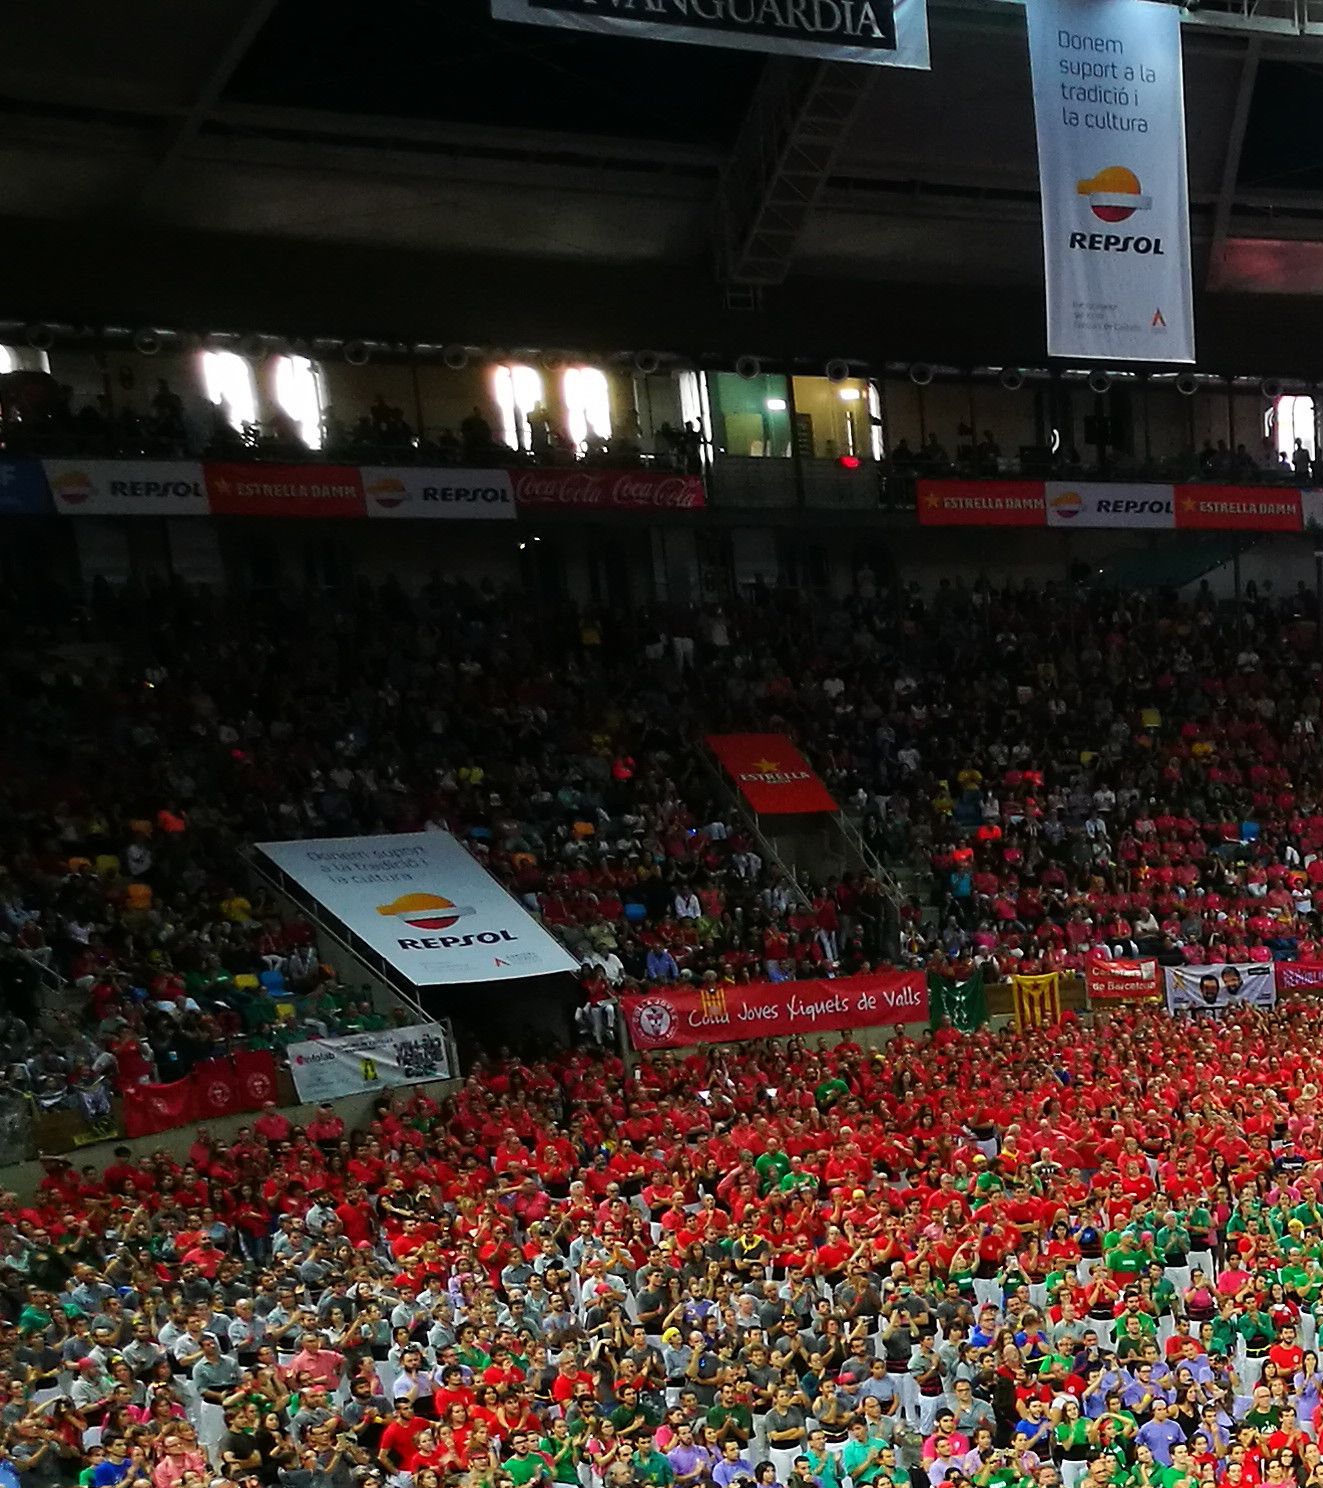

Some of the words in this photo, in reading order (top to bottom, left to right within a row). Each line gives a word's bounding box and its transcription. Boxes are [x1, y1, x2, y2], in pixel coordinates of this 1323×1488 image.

[1058, 30, 1123, 55] Donem
[1059, 59, 1118, 81] suport
[1124, 67, 1135, 82] a
[1140, 64, 1156, 84] la
[1061, 83, 1130, 107] tradició
[1134, 89, 1139, 107] i
[1063, 107, 1079, 128] la
[1085, 110, 1149, 134] cultura
[1069, 232, 1164, 256] REPSOL
[110, 481, 203, 498] REPSOL
[423, 487, 510, 503] REPSOL
[943, 498, 1004, 509] ESTRELLA
[1005, 498, 1045, 510] DAMM
[1097, 499, 1174, 514] REPSOL
[1199, 502, 1257, 514] ESTRELLA
[1258, 503, 1297, 516] DAMM
[397, 929, 518, 950] REPSOL
[737, 1002, 778, 1021] Joves
[788, 995, 849, 1021] Xiquets
[857, 992, 877, 1010] de
[883, 986, 921, 1007] Valls
